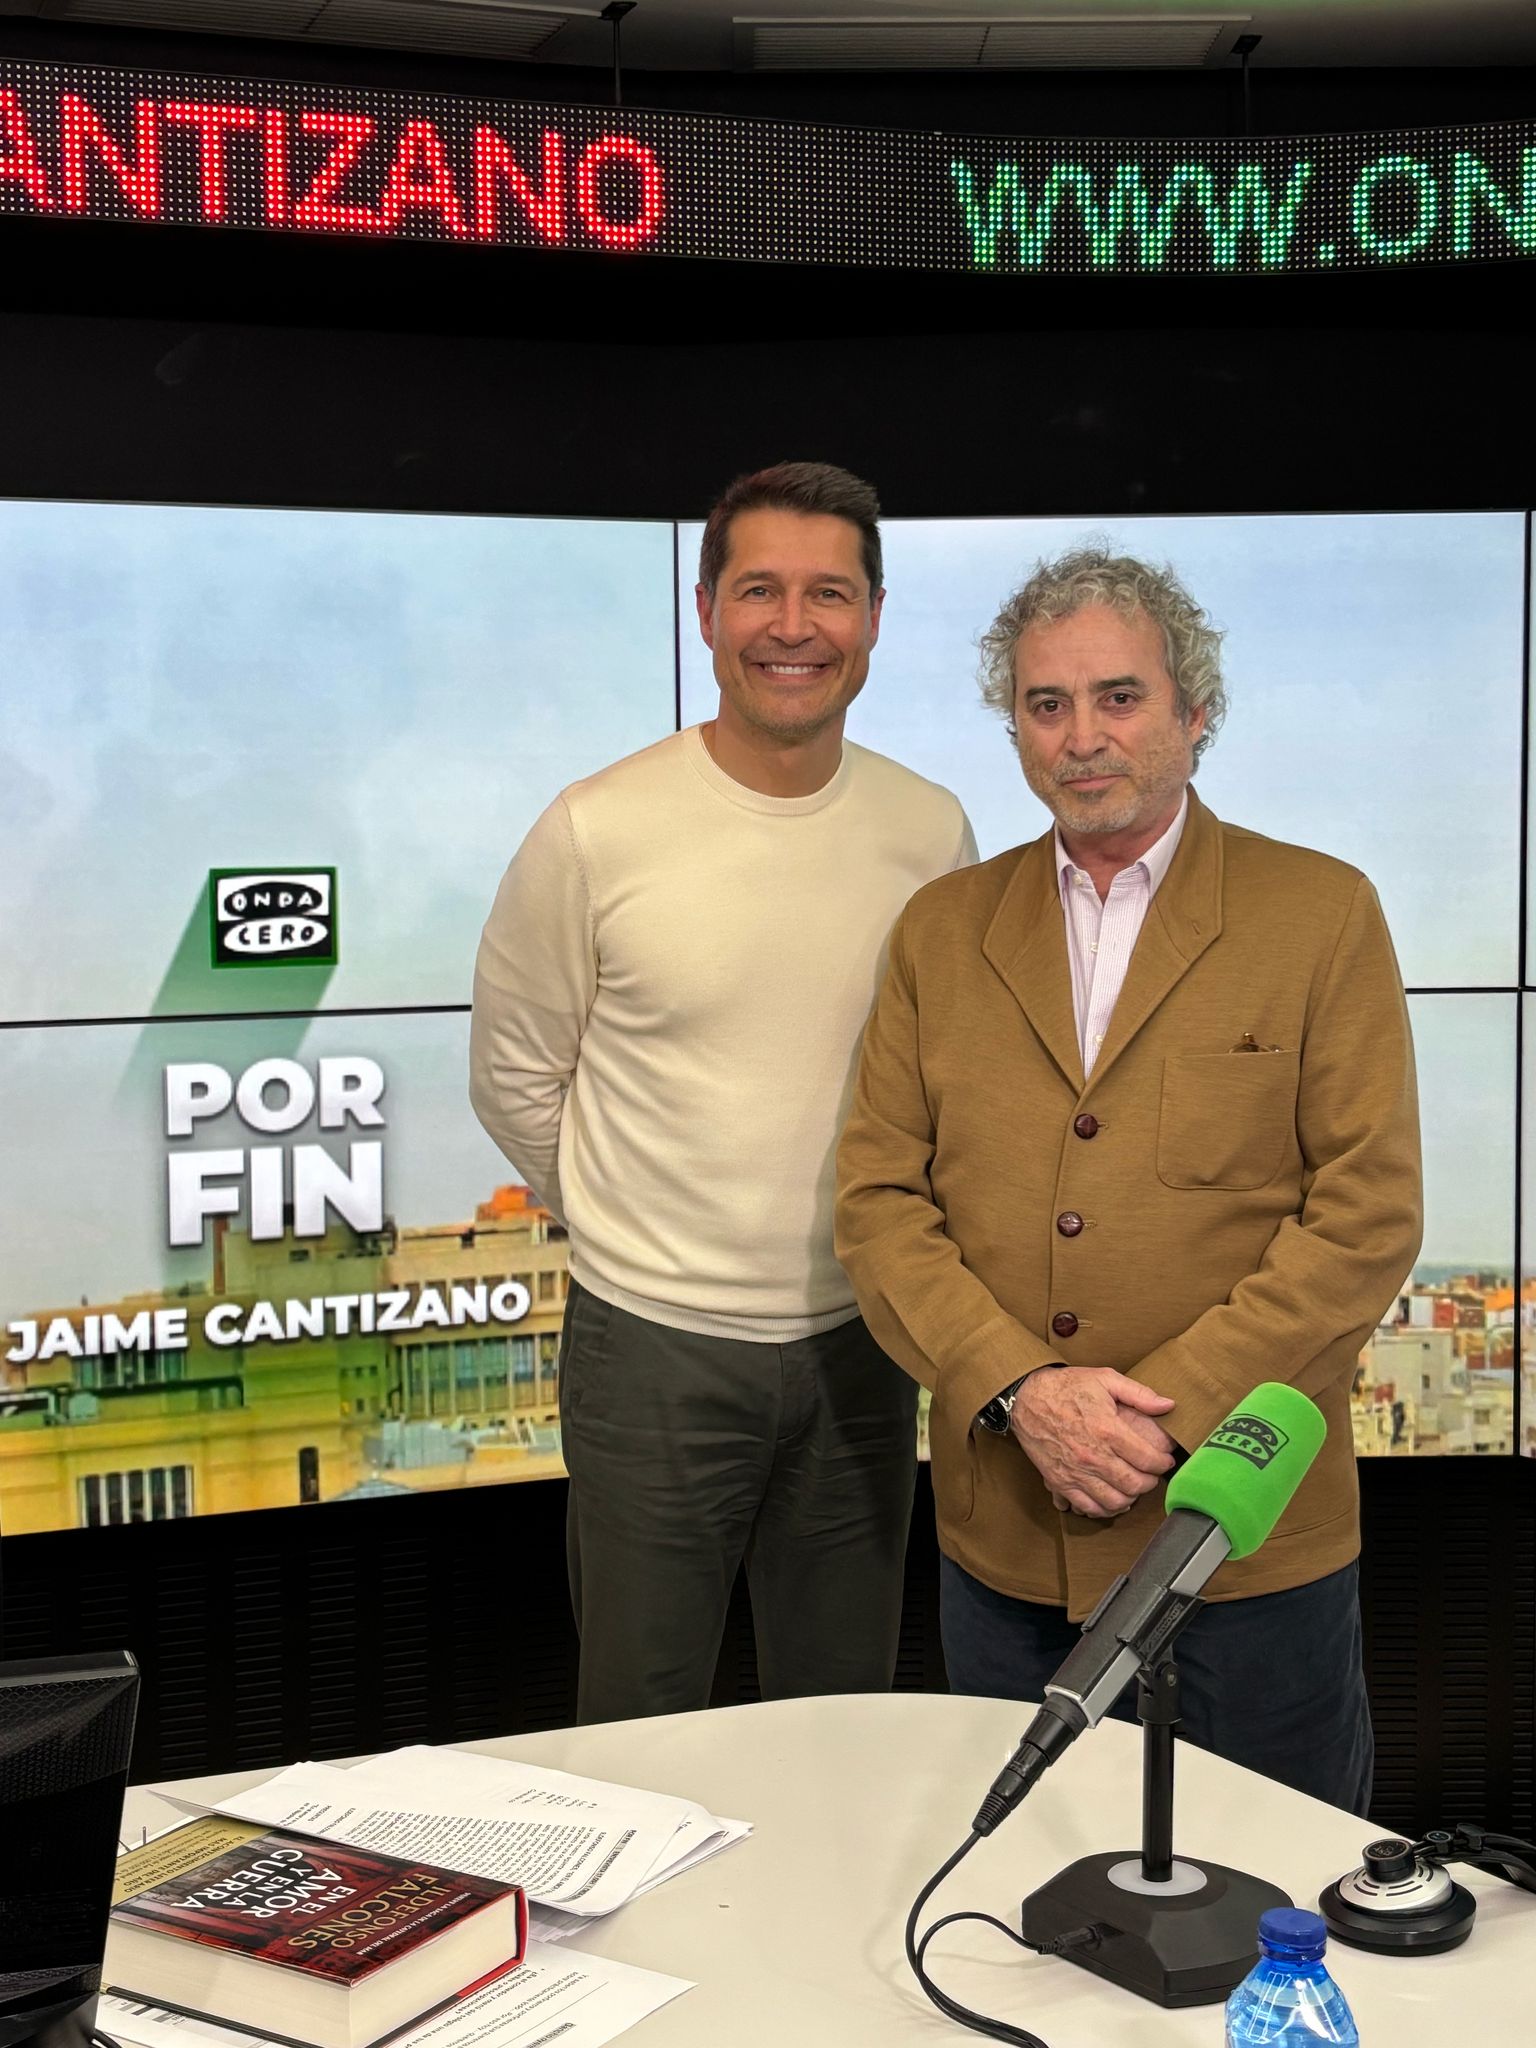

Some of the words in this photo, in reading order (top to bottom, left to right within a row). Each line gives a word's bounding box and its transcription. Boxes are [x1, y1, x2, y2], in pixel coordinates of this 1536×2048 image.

[231, 890, 315, 911] ONDA
[237, 922, 316, 947] CERO
[165, 1056, 387, 1137] POR
[167, 1140, 386, 1248] FIN
[5, 1308, 190, 1363] JAIME
[203, 1281, 532, 1346] CANTIZANO
[1217, 1432, 1263, 1455] CERO
[1226, 1420, 1273, 1443] ONDA
[170, 1849, 304, 1909] GUERRA
[289, 1867, 313, 1877] Y
[240, 1868, 342, 1918] AMOR
[255, 1876, 295, 1893] EN
[318, 1885, 357, 1903] EN
[222, 1892, 264, 1907] LA
[287, 1873, 438, 1949] FALCONES
[290, 1902, 326, 1914] EL
[330, 1886, 451, 1948] ILDEFONSO
